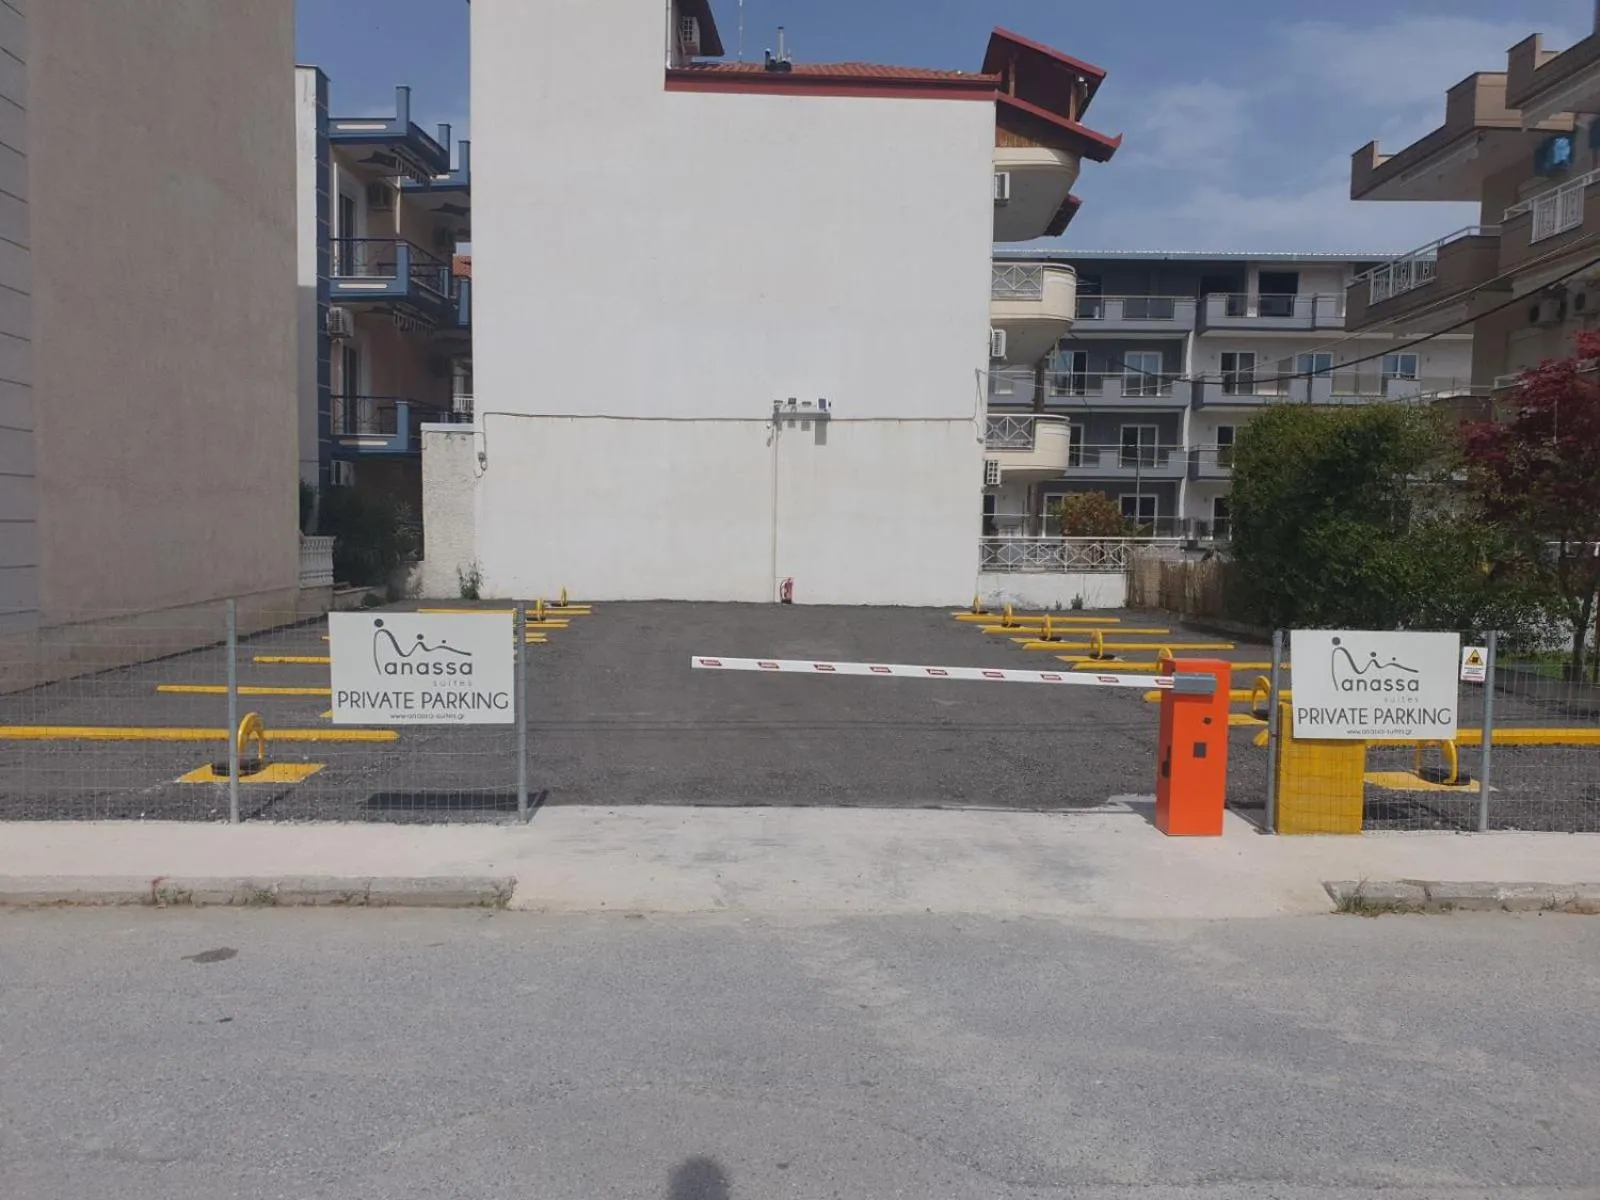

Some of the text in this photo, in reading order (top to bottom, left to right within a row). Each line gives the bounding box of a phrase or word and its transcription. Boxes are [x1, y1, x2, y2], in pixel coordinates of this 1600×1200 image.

[384, 661, 473, 675] anassa
[1341, 678, 1419, 691] anassa
[337, 691, 509, 710] PRIVATE PARKING
[1298, 707, 1452, 725] PRIVATE PARKING
